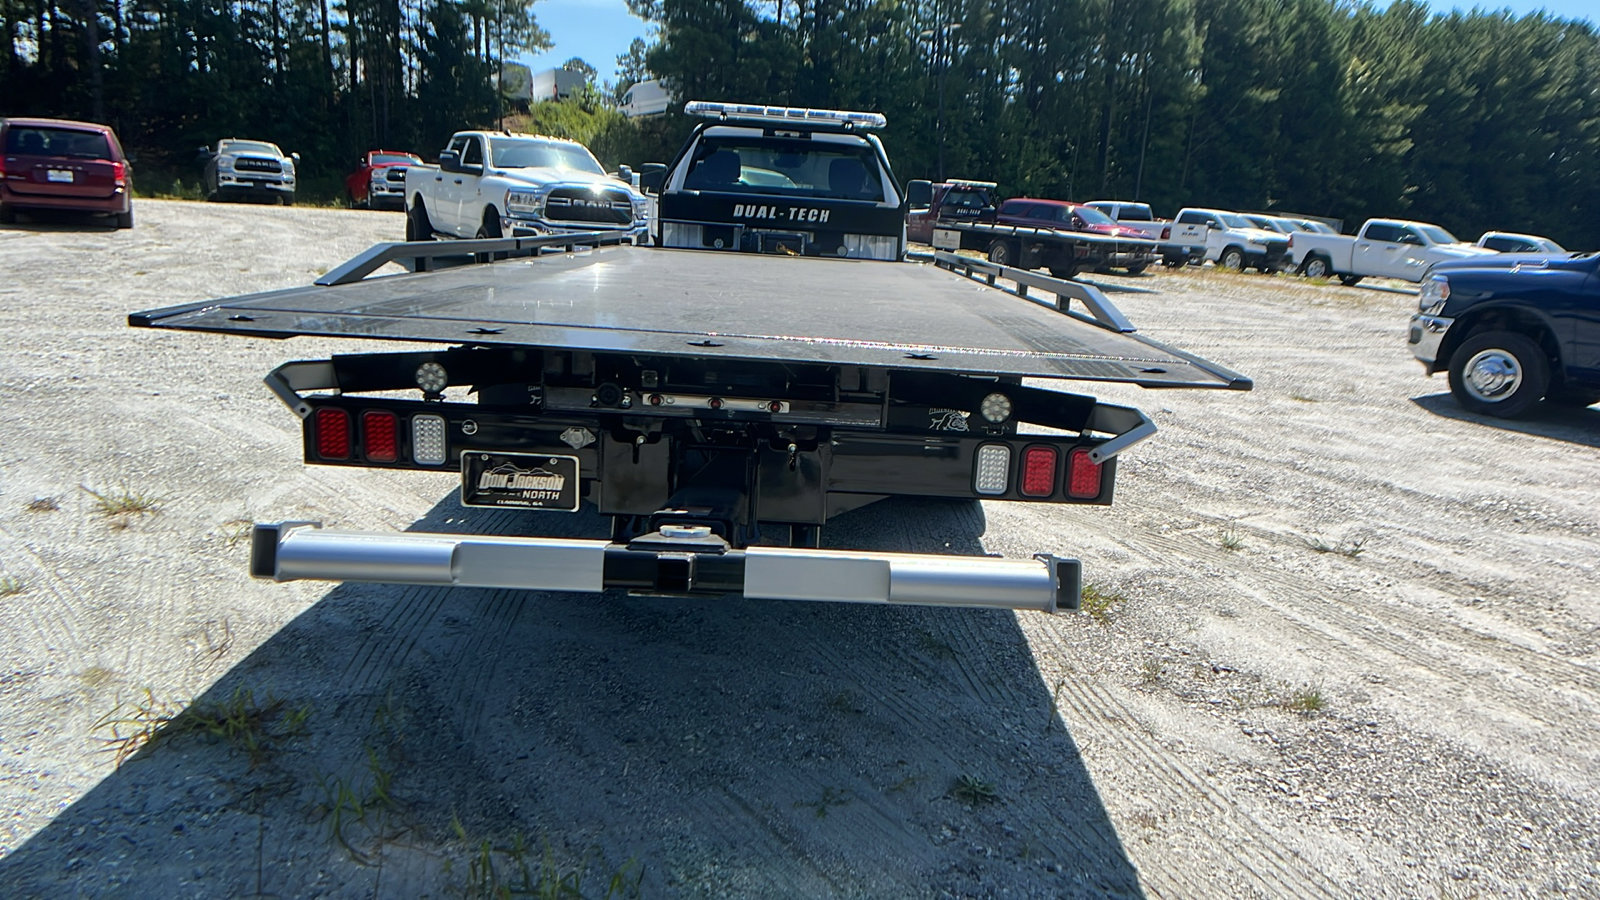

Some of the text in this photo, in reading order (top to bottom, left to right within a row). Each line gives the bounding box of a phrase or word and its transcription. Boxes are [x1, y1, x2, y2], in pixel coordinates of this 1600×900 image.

[479, 472, 565, 491] DON JACKSON
[522, 490, 560, 500] NORTH
